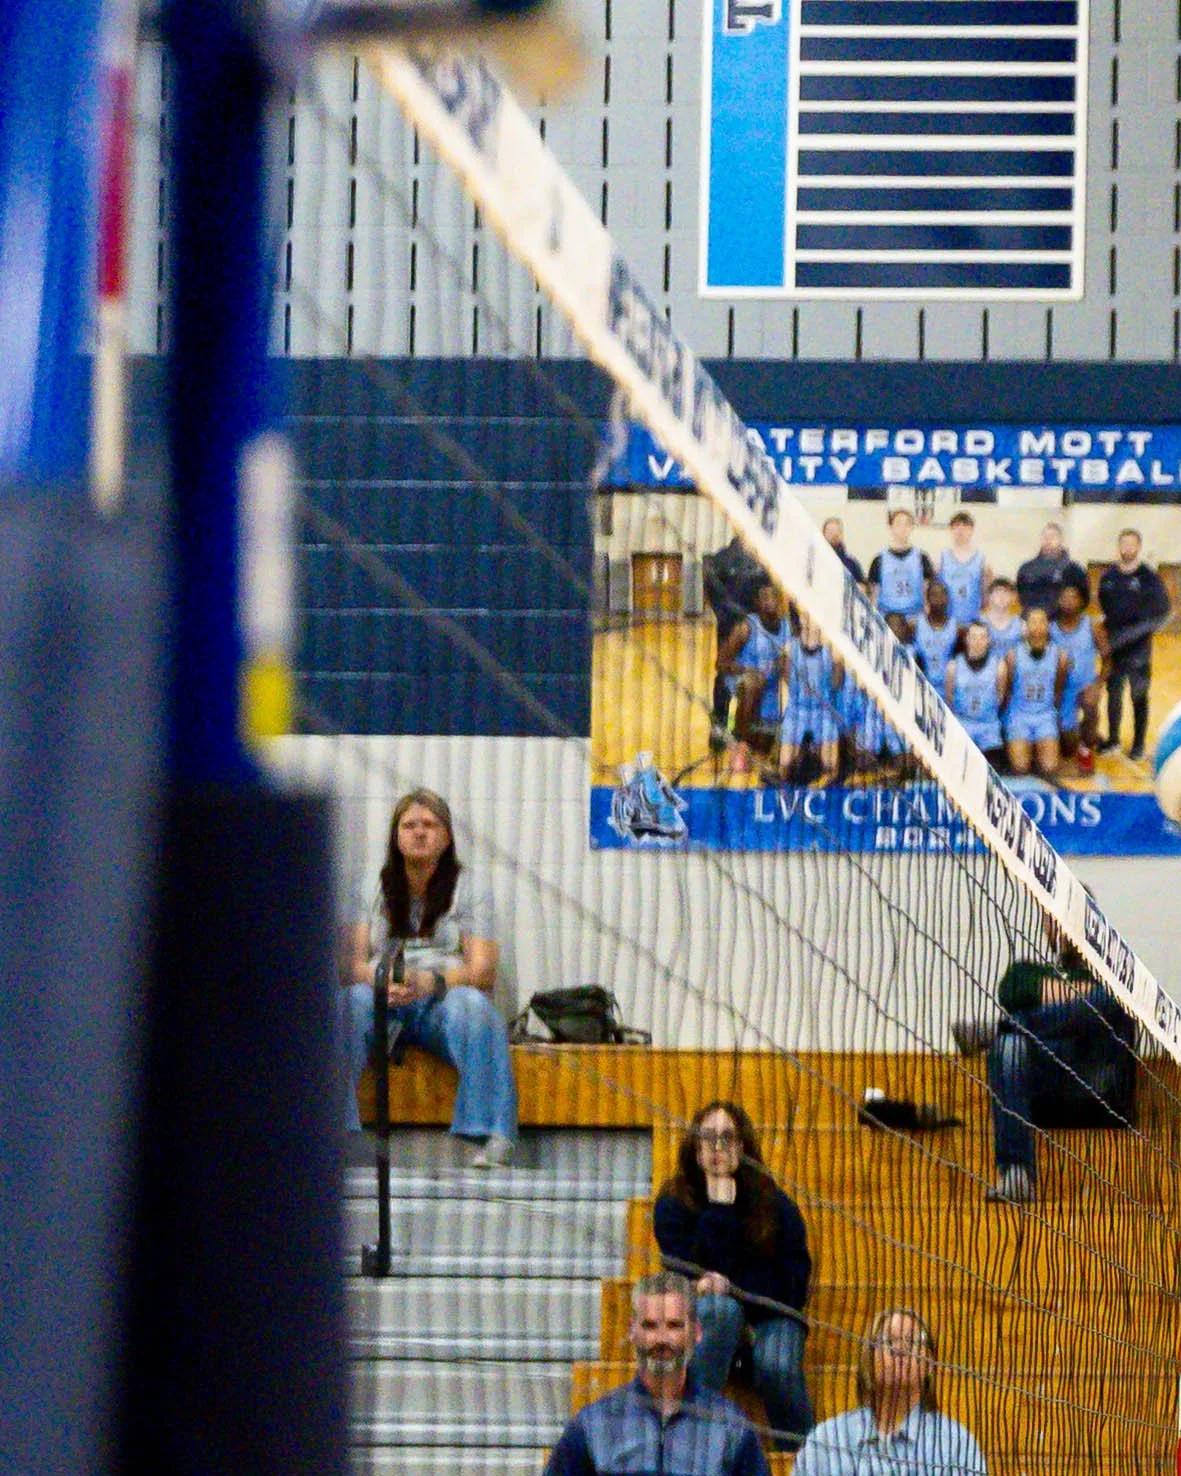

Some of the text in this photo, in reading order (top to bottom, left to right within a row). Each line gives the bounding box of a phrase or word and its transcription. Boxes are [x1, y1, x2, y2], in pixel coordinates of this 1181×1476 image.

[745, 427, 1153, 458] ATERFORD MOTT
[647, 455, 858, 482] VITY
[752, 789, 826, 824] LVC
